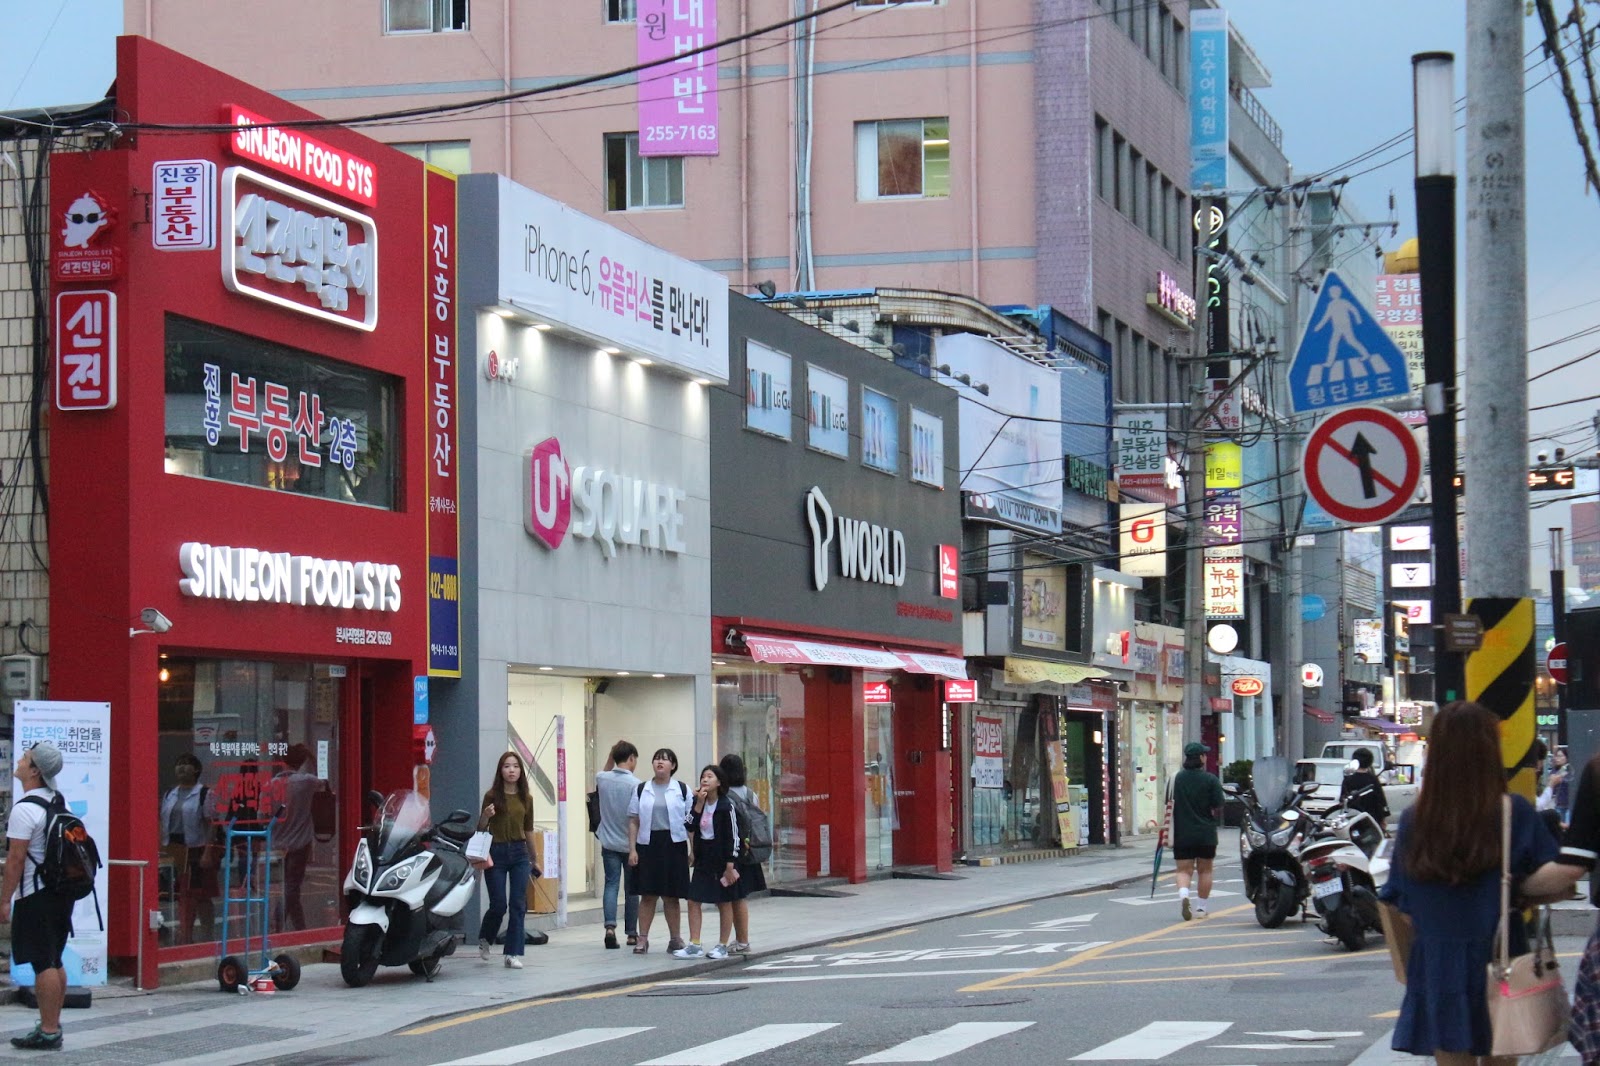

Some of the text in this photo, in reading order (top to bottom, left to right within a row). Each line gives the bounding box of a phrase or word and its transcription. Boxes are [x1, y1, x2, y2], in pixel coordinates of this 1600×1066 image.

[646, 125, 716, 141] 255-7163
[236, 114, 373, 198] SINJEON FOOD SYS
[160, 166, 201, 183] 진흥
[161, 186, 198, 242] 부동산
[235, 193, 372, 311] 신전떡볶이
[60, 259, 110, 275] 신전떡볶이
[524, 223, 578, 292] iPhone
[598, 255, 665, 332] 유플러스를
[669, 285, 709, 348] 만나다!
[63, 300, 102, 400] 신전
[432, 224, 451, 478] 진흥 부동산
[1307, 376, 1396, 405] 횡단보도
[203, 362, 357, 471] 진흥 부동산 2층
[1128, 420, 1154, 435] 대호
[1122, 437, 1162, 452] 부동산
[1122, 454, 1160, 470] 컨설팅
[573, 466, 687, 558] SQUARE
[838, 516, 906, 587] WORLD
[181, 542, 401, 612] SINJEON FOOD SYS
[1210, 566, 1240, 584] 뉴욕
[1211, 585, 1239, 599] 피자
[1211, 605, 1239, 614] PIZZA
[1233, 682, 1259, 692] PIZZA
[21, 725, 102, 740] 압도적인 취업률
[57, 740, 103, 754] 책임진다!
